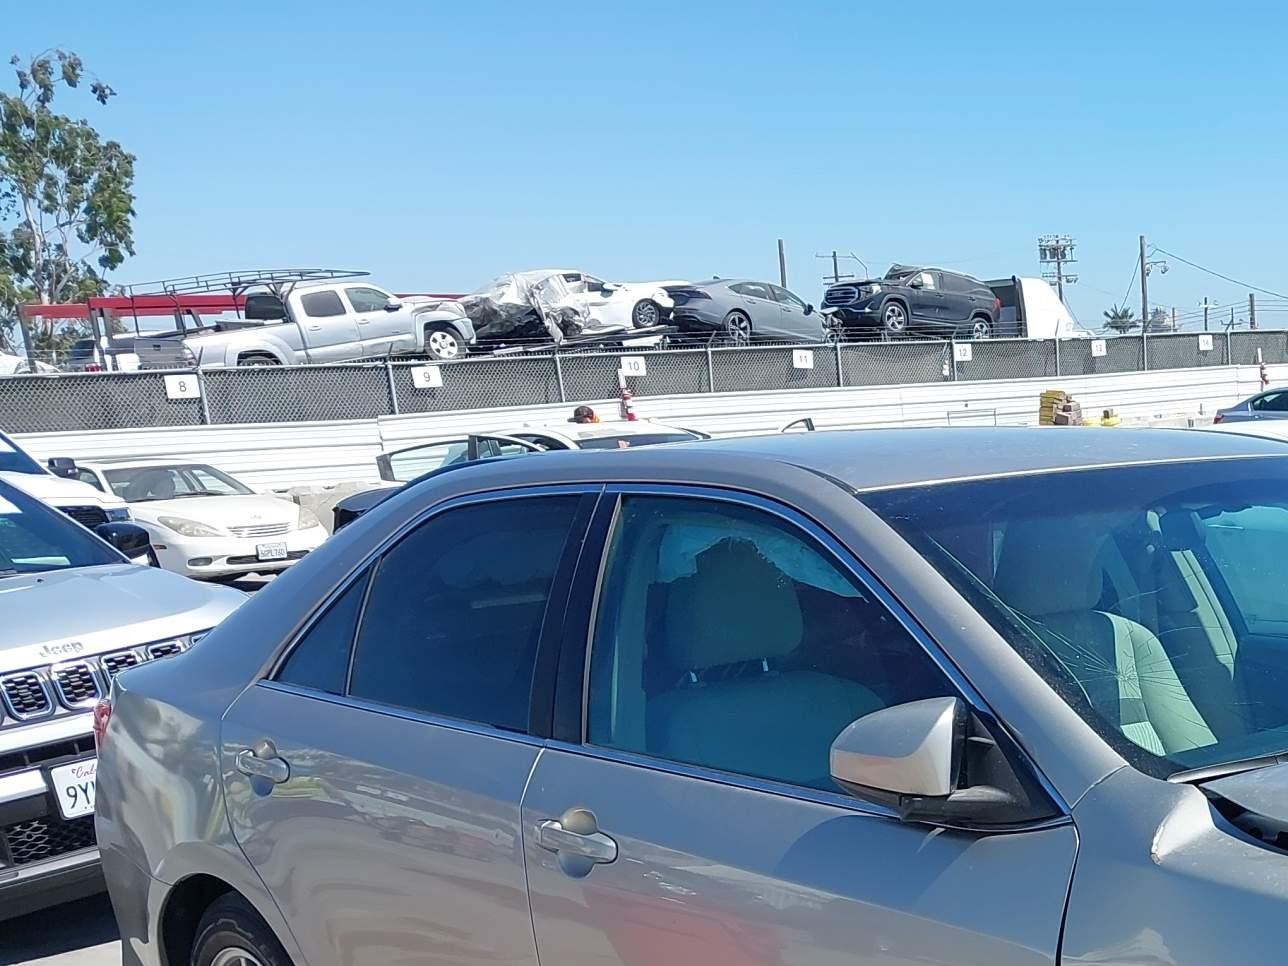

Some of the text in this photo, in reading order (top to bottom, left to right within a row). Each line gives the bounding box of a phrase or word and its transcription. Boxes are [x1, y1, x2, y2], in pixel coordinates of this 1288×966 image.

[628, 361, 640, 371] 10
[423, 371, 431, 382] 9
[178, 381, 187, 392] 8
